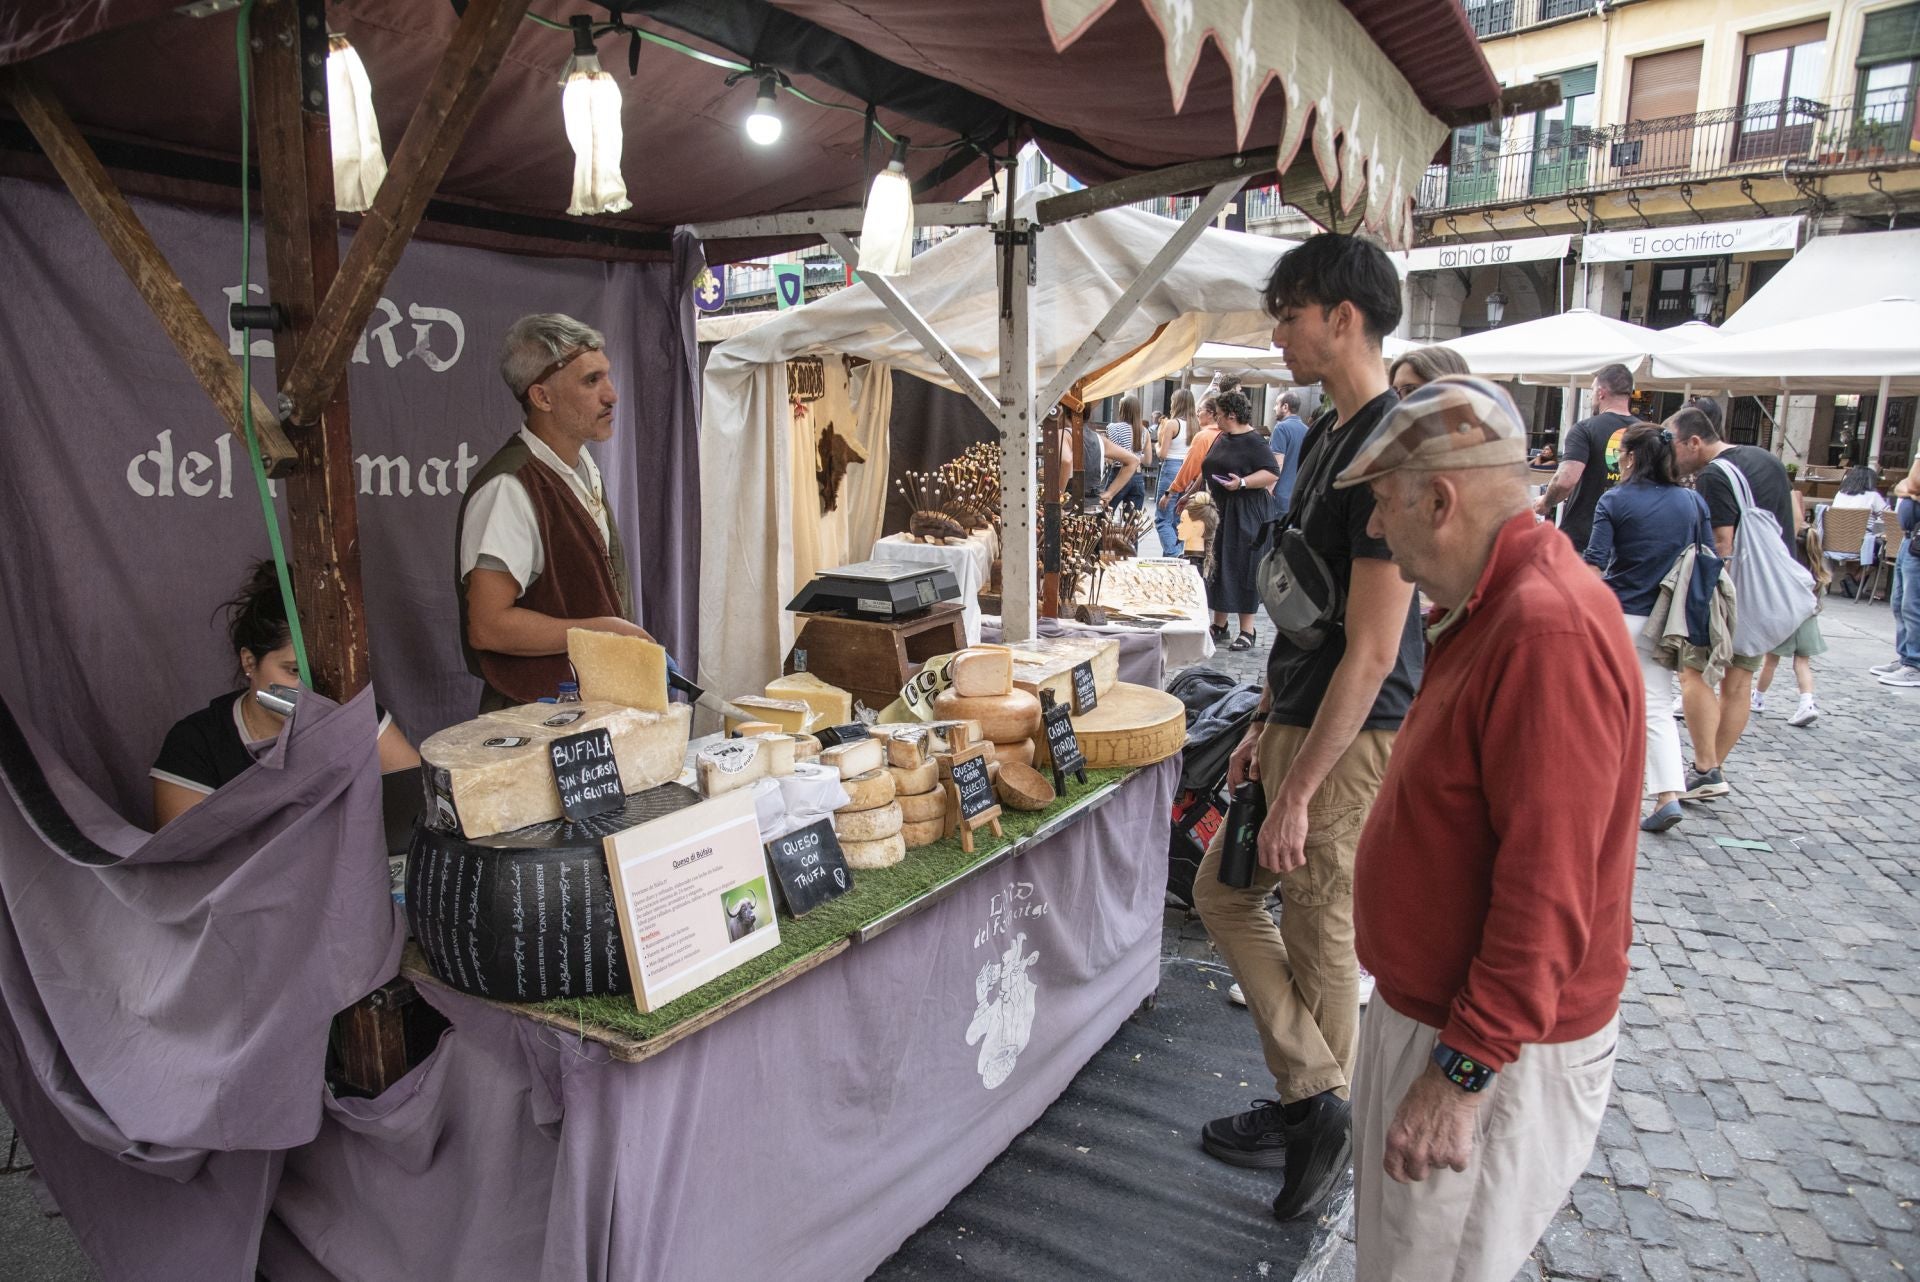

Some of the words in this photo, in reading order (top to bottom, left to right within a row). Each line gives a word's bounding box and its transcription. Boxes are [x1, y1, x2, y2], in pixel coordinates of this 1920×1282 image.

[127, 429, 233, 498] del
[1607, 472, 1621, 480] MY
[1048, 718, 1071, 739] CABRA
[553, 733, 613, 767] BUFALA
[1053, 735, 1076, 757] CURADO
[1081, 730, 1164, 763] UYÈRE
[953, 762, 975, 778] QUESO
[961, 776, 986, 797] SELECTO
[783, 832, 819, 855] QUESO
[672, 857, 690, 869] Queso
[801, 851, 820, 867] CON
[536, 864, 545, 900] RISERVA
[794, 866, 826, 889] TRUFA
[538, 902, 546, 933] BIANCA
[584, 963, 593, 992] RISERVA
